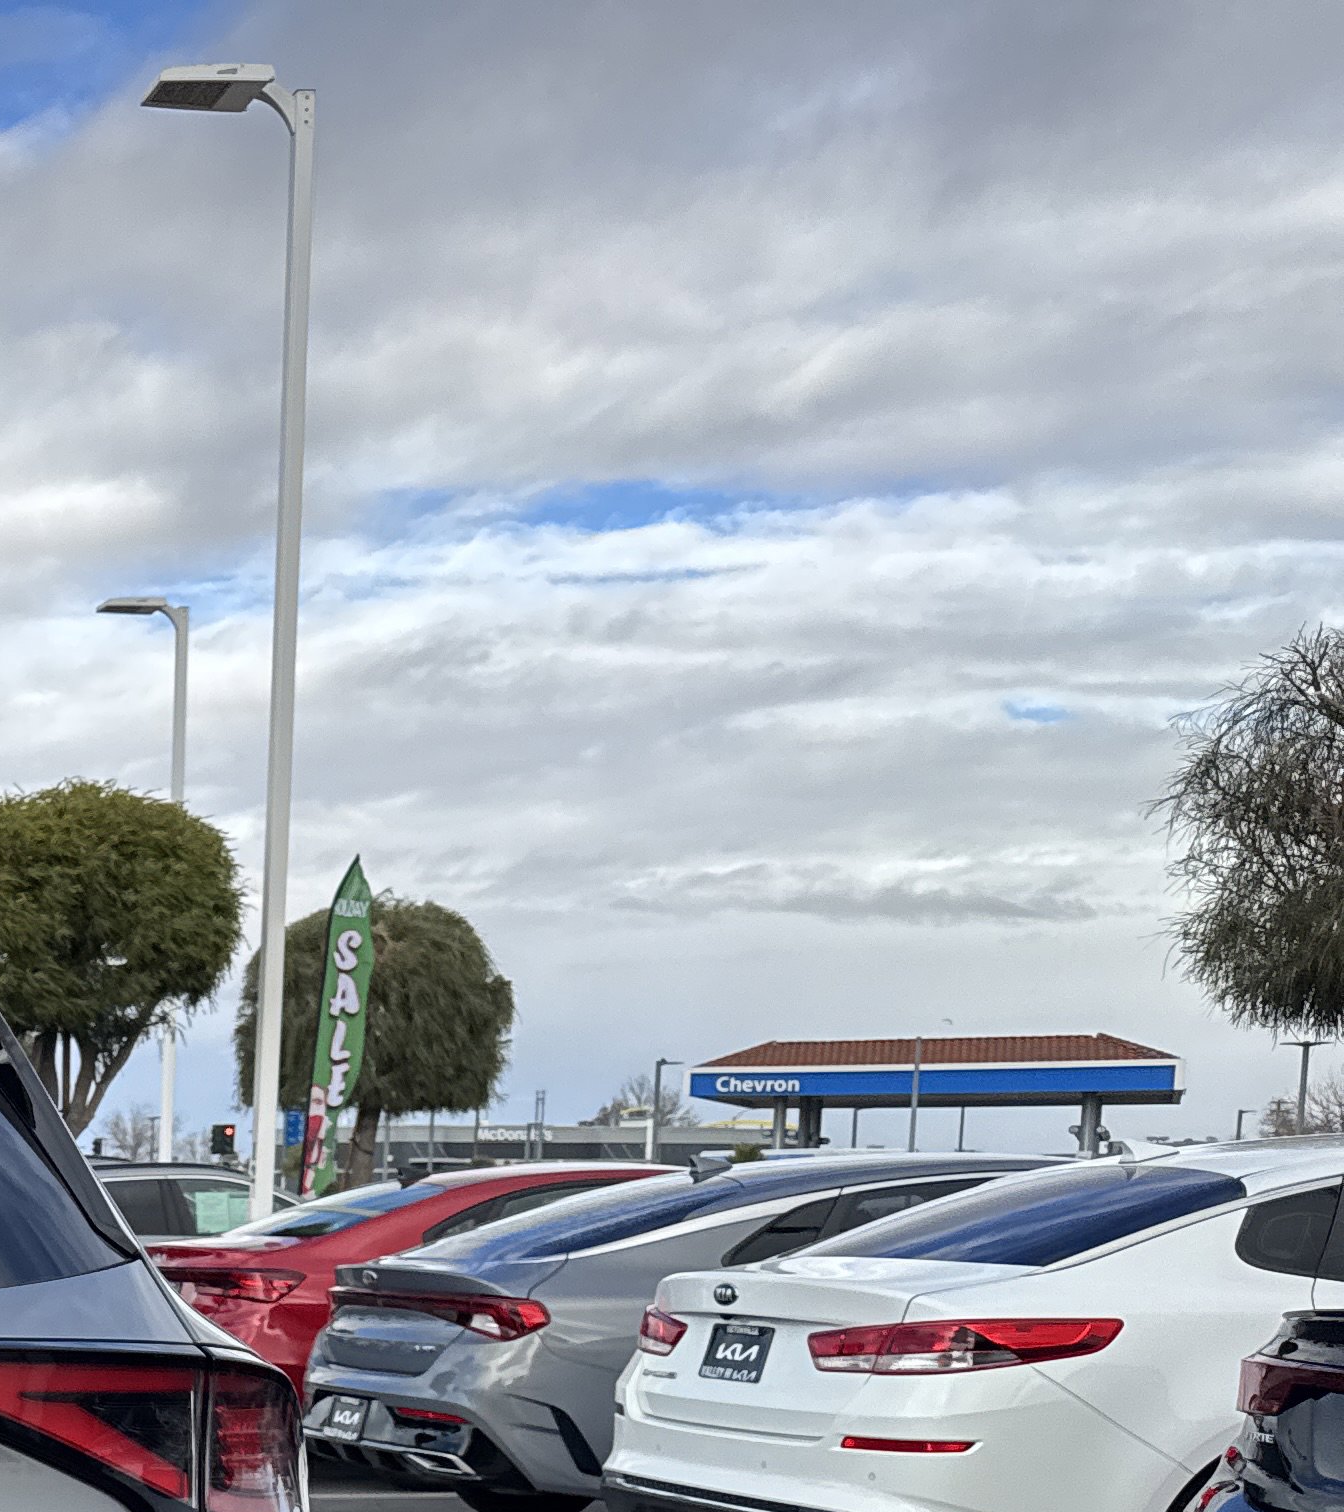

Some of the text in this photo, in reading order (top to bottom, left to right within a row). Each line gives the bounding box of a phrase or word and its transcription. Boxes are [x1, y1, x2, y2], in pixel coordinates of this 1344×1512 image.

[326, 929, 363, 1107] SALE
[715, 1075, 801, 1093] Chevron
[477, 1127, 553, 1142] McDonals
[715, 1342, 761, 1362] KIA
[333, 1409, 361, 1425] KIA
